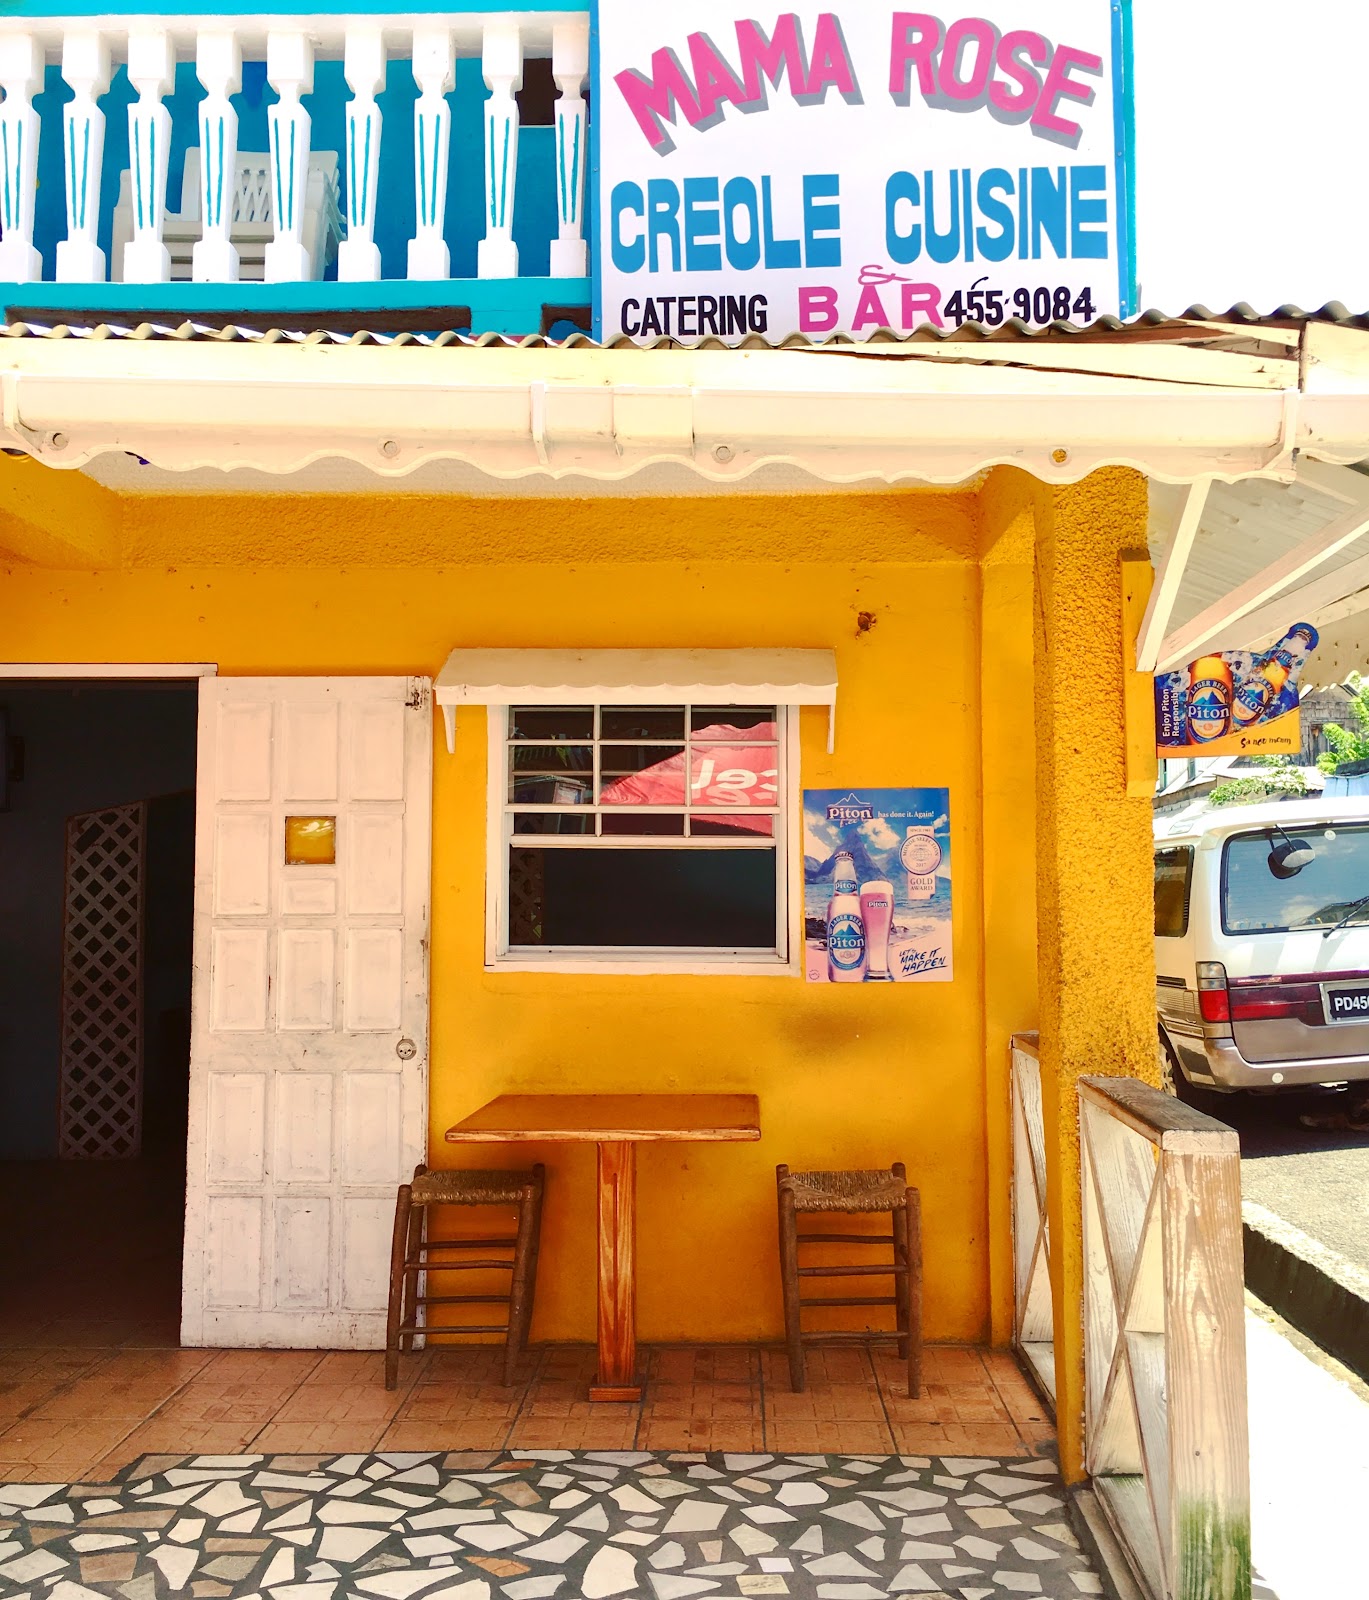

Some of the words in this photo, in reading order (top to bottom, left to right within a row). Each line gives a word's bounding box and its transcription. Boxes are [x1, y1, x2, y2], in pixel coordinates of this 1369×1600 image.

[614, 12, 864, 156] MAMA
[889, 12, 1103, 150] ROSE
[610, 173, 842, 273] CREOLE
[884, 165, 1108, 264] CUISINE
[857, 264, 913, 286] &
[621, 294, 768, 337] CATERING
[798, 282, 945, 332] BAR
[1190, 681, 1211, 695] LAGER
[1212, 681, 1228, 694] BEER
[1161, 689, 1170, 711] Piton
[1188, 706, 1230, 719] Piton
[1162, 713, 1172, 737] Enjoy
[829, 807, 872, 819] Piton
[914, 811, 934, 819] Again!
[835, 882, 857, 891] Piton
[831, 915, 847, 927] LAGER
[829, 936, 864, 948] Piton
[901, 951, 927, 964] MAKE
[929, 947, 941, 958] IT
[902, 956, 946, 973] HAPPEN
